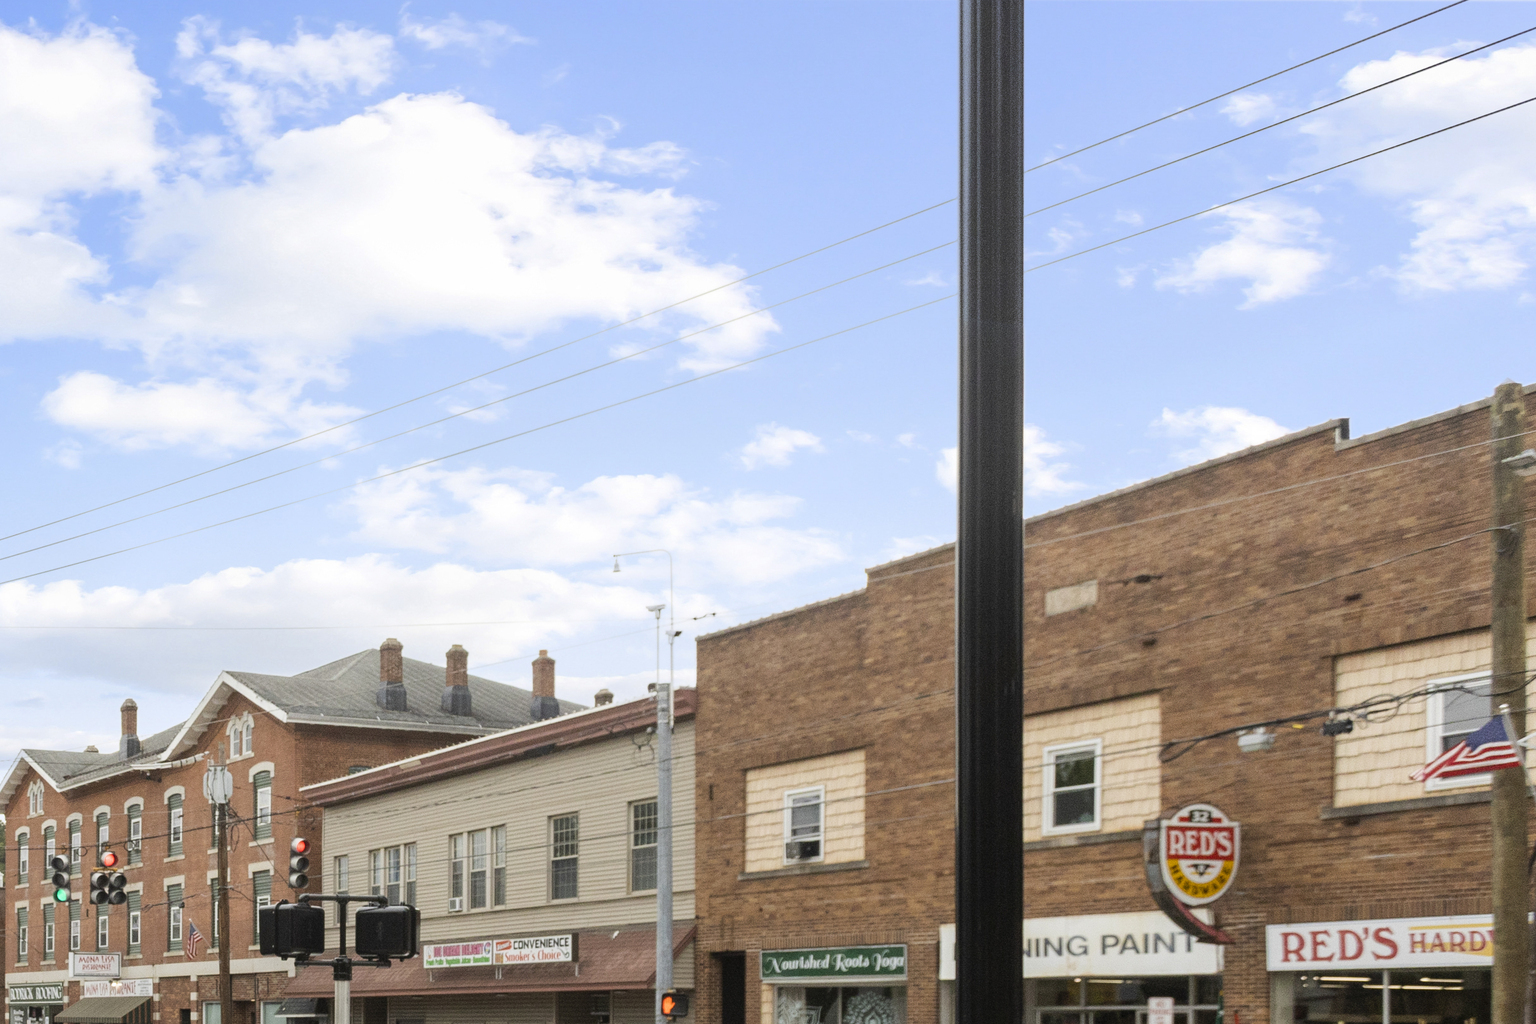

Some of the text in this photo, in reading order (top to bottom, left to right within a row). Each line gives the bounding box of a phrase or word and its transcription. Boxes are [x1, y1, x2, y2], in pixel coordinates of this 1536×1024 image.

[1169, 830, 1232, 857] RED'S
[1171, 864, 1231, 895] HARDWARE
[504, 948, 562, 962] Smoker's Choice
[513, 937, 570, 950] CONVENIENCE
[1101, 932, 1195, 955] PAINT
[1280, 927, 1399, 963] RED'S
[78, 955, 100, 964] MONA
[764, 950, 904, 974] Nourished Roots Yoga
